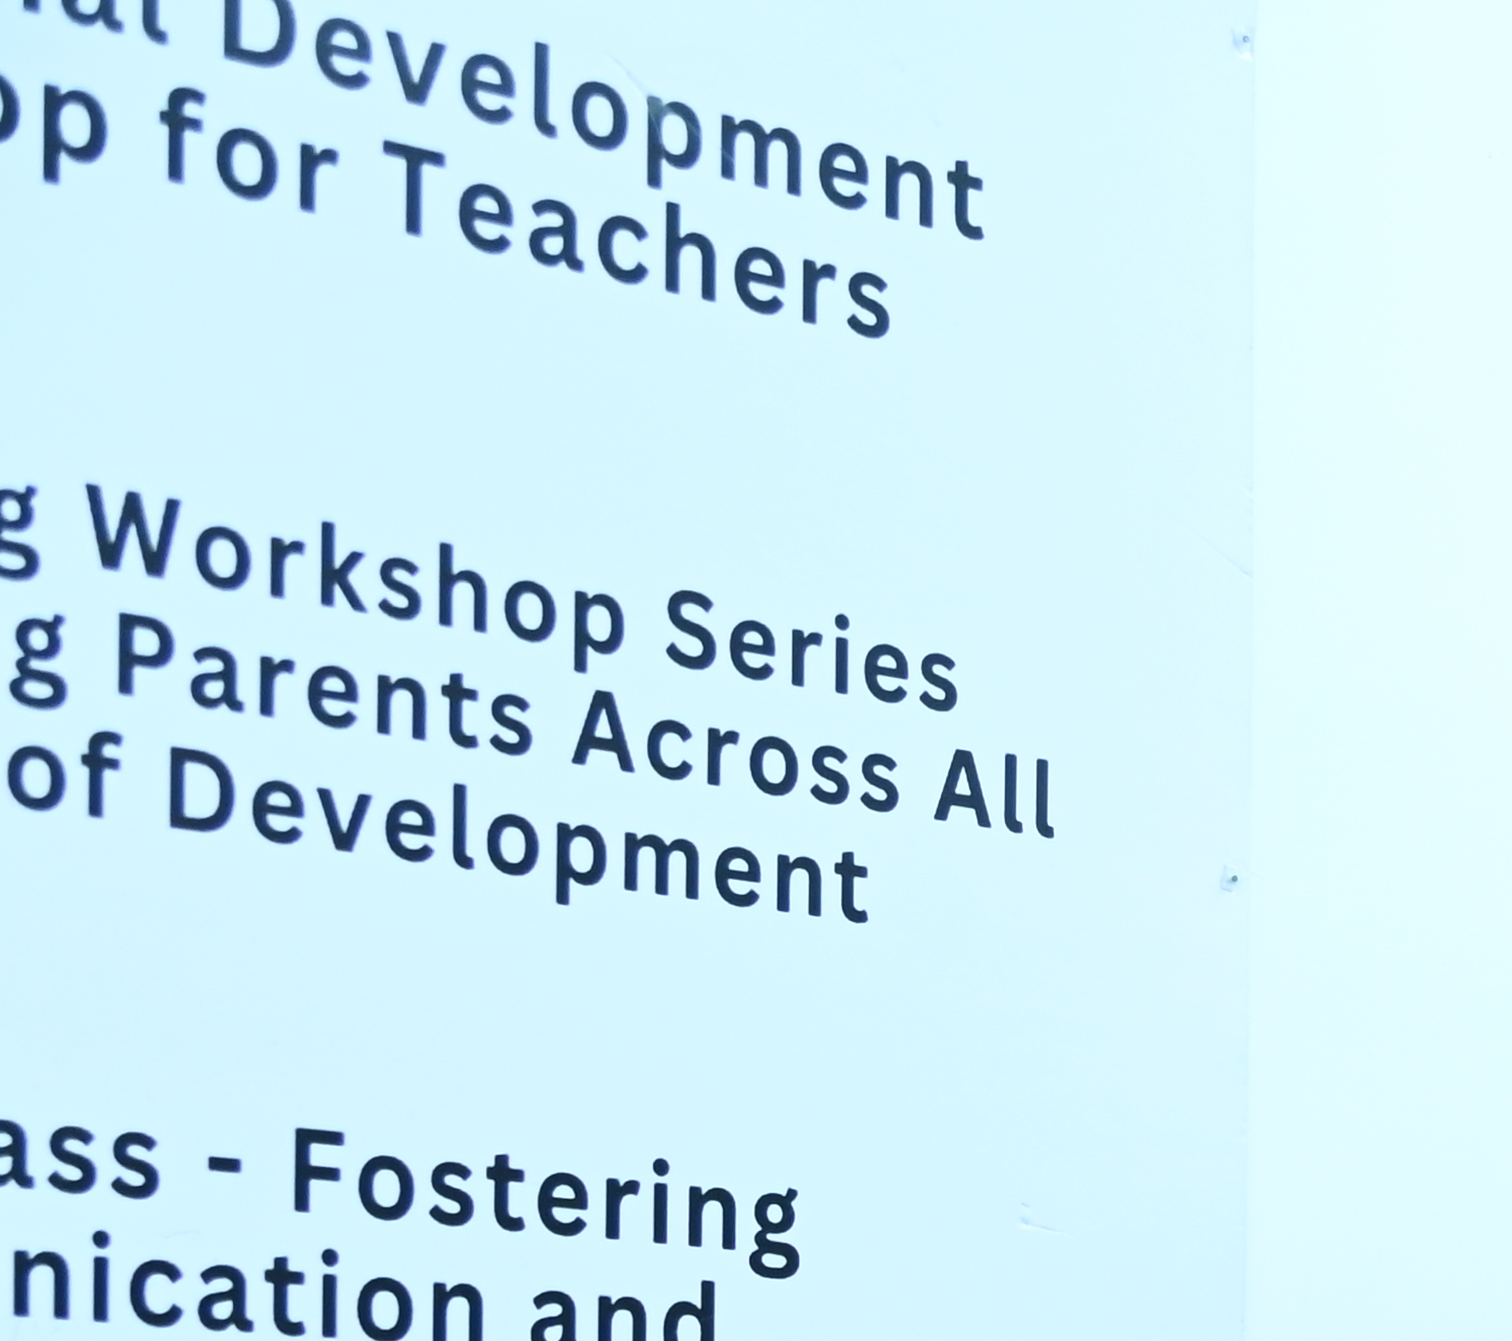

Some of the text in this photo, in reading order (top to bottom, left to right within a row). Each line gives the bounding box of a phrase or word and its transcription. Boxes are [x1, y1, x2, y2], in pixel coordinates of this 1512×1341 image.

[159, 87, 338, 213] for
[382, 139, 891, 339] Teachers
[223, 0, 985, 240] Development
[85, 483, 625, 674] Workshop
[665, 589, 959, 712] Series
[7, 730, 869, 925] of Development
[8, 612, 1056, 839] g Parents Across All
[293, 1127, 801, 1280] Fostering
